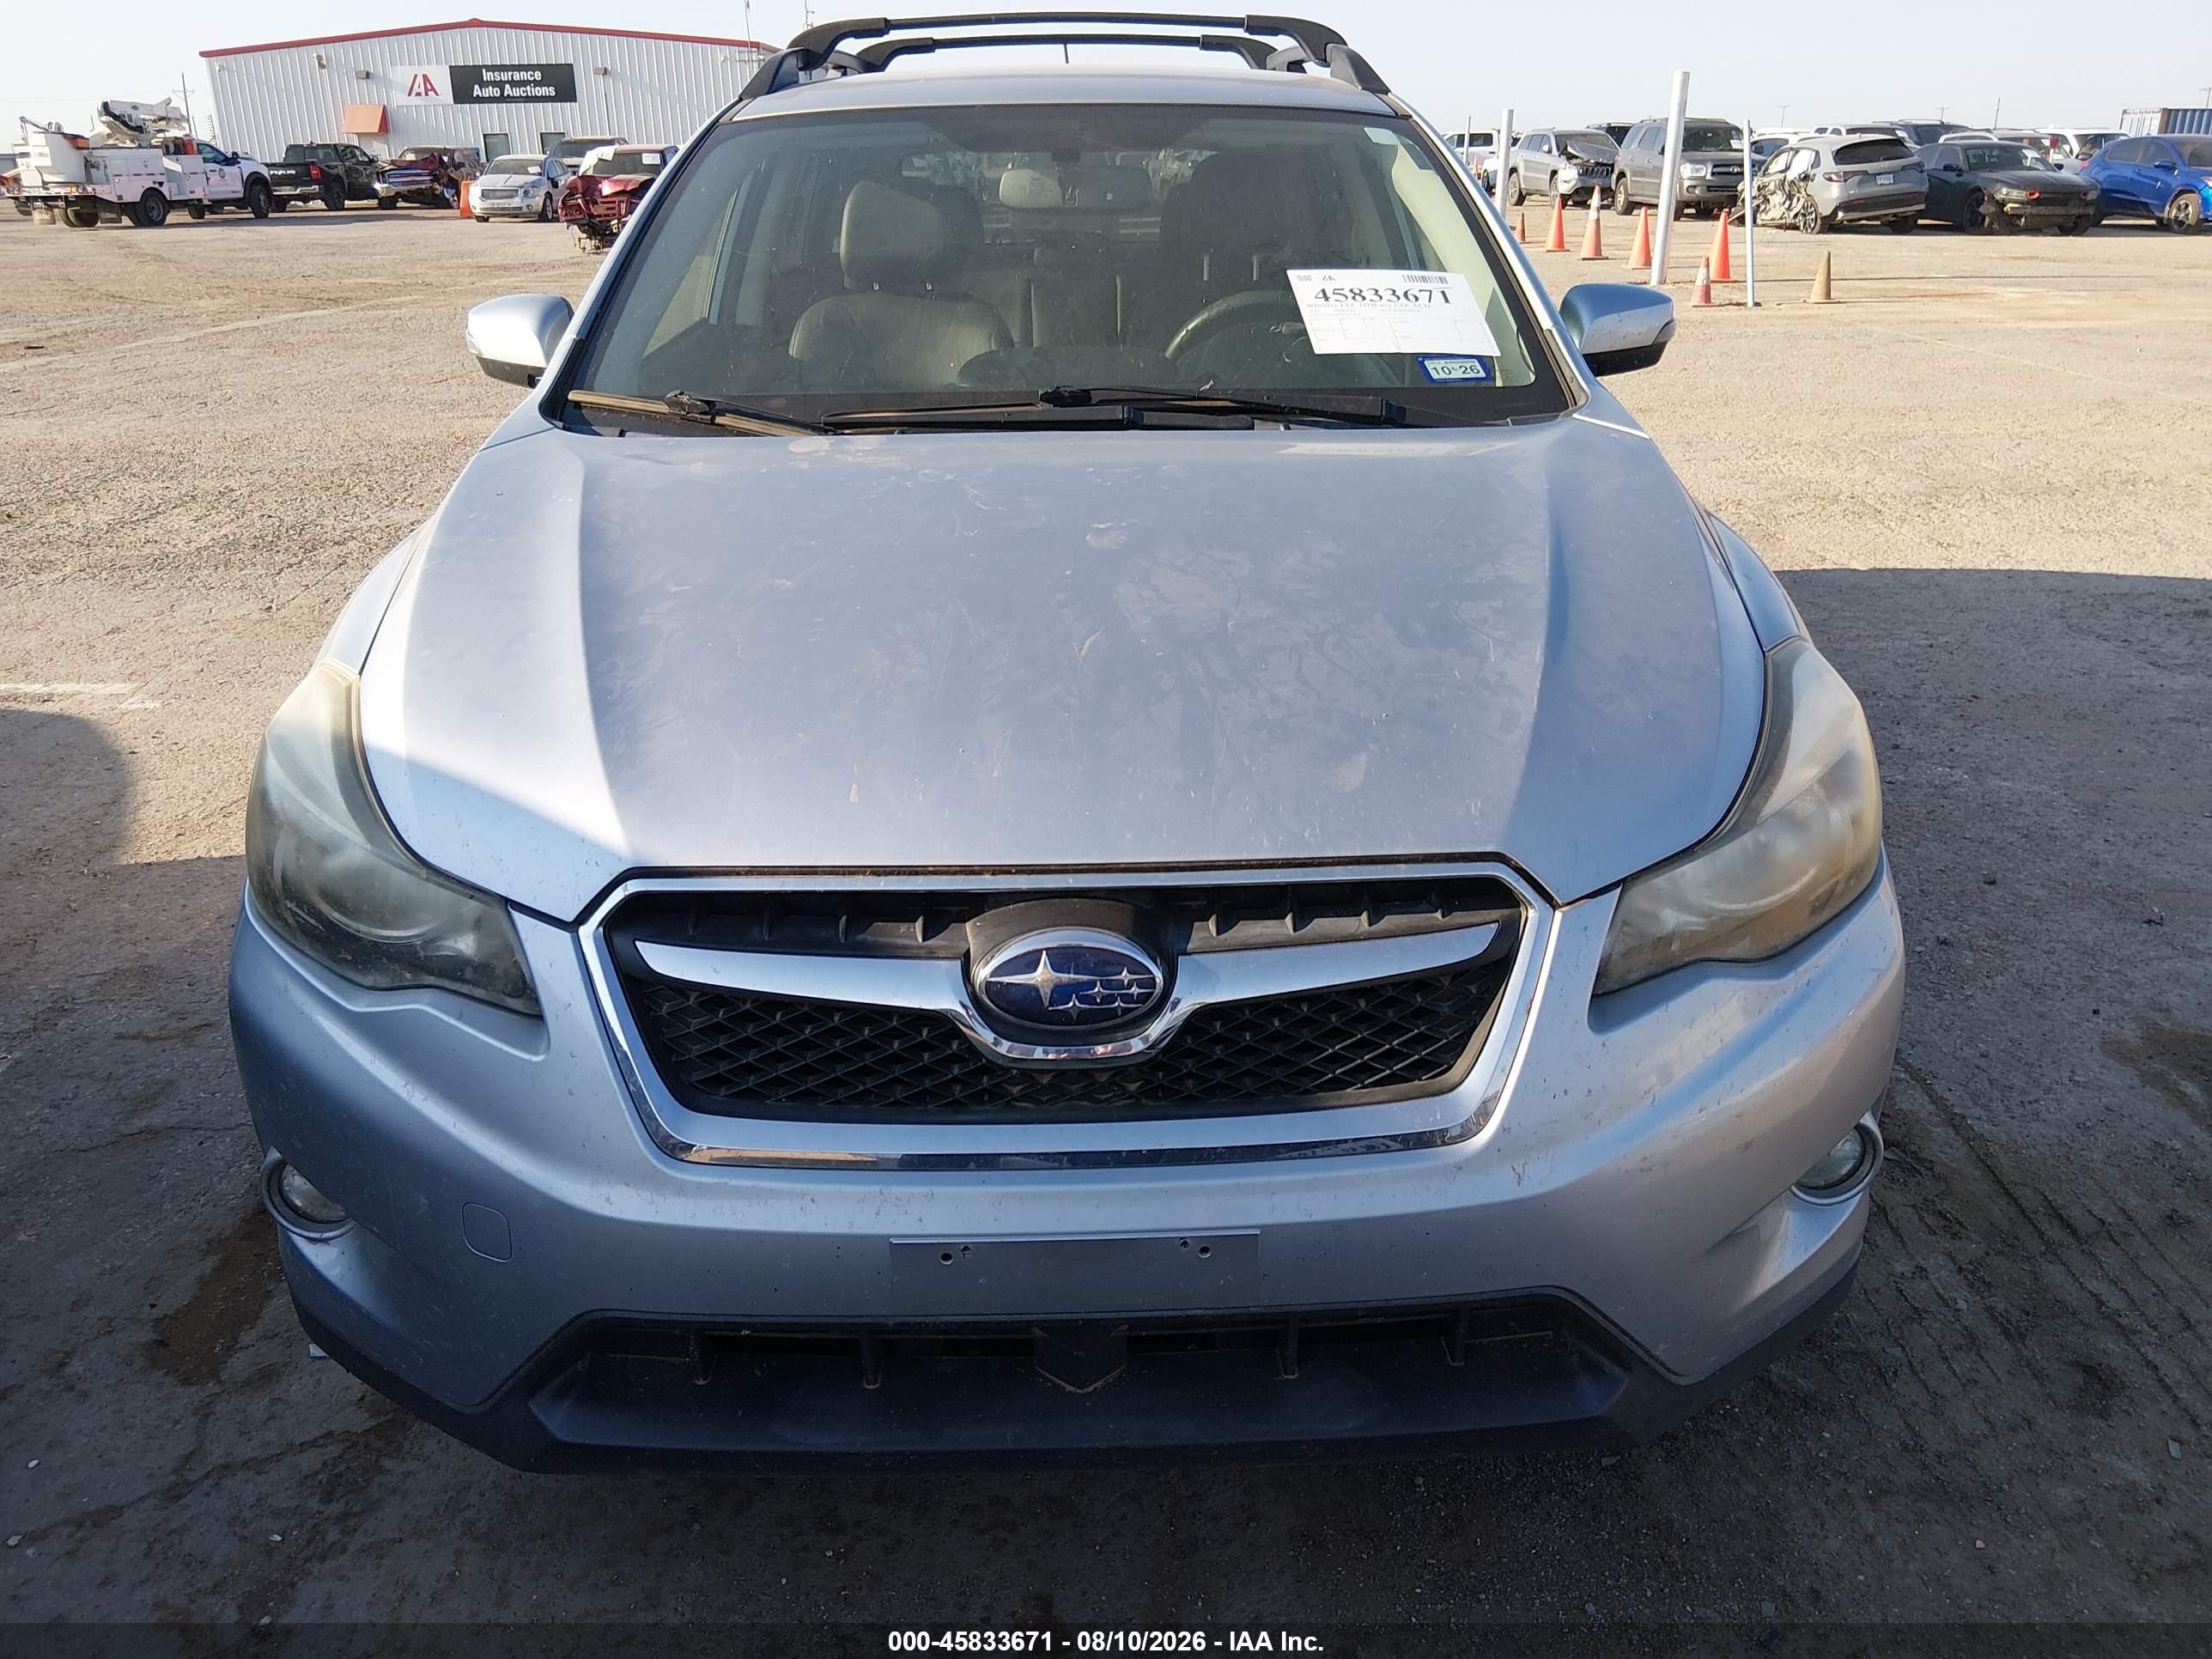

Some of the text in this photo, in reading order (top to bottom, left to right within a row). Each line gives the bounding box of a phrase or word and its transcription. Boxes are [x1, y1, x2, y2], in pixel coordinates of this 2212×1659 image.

[482, 68, 542, 82] Insurance
[473, 83, 556, 97] Auto Auctions
[1315, 288, 1451, 304] 45833671
[1431, 365, 1480, 375] 10 26
